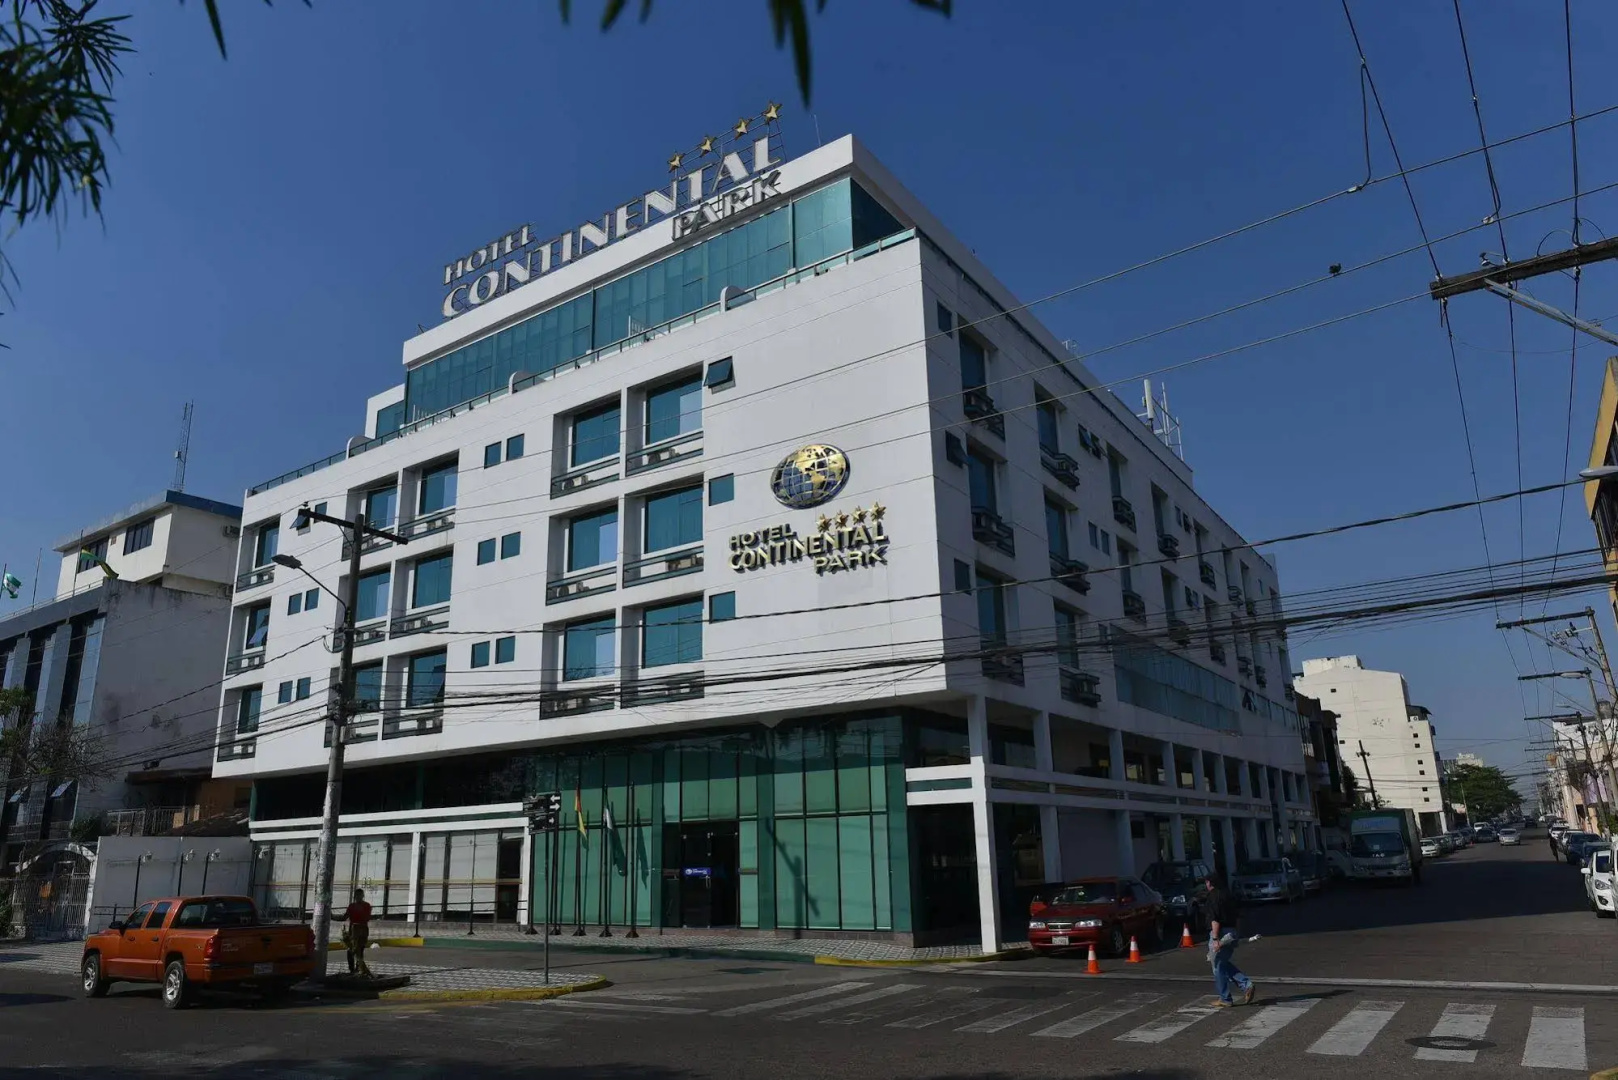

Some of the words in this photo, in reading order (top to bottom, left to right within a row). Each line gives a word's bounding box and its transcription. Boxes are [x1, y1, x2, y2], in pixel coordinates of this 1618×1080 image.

[442, 136, 781, 318] CONTINENTAL
[672, 170, 782, 240] PARK
[444, 223, 534, 285] HOTEL
[728, 521, 888, 571] CONTINENTAL
[729, 523, 796, 550] HOTEL
[814, 545, 888, 574] PARK
